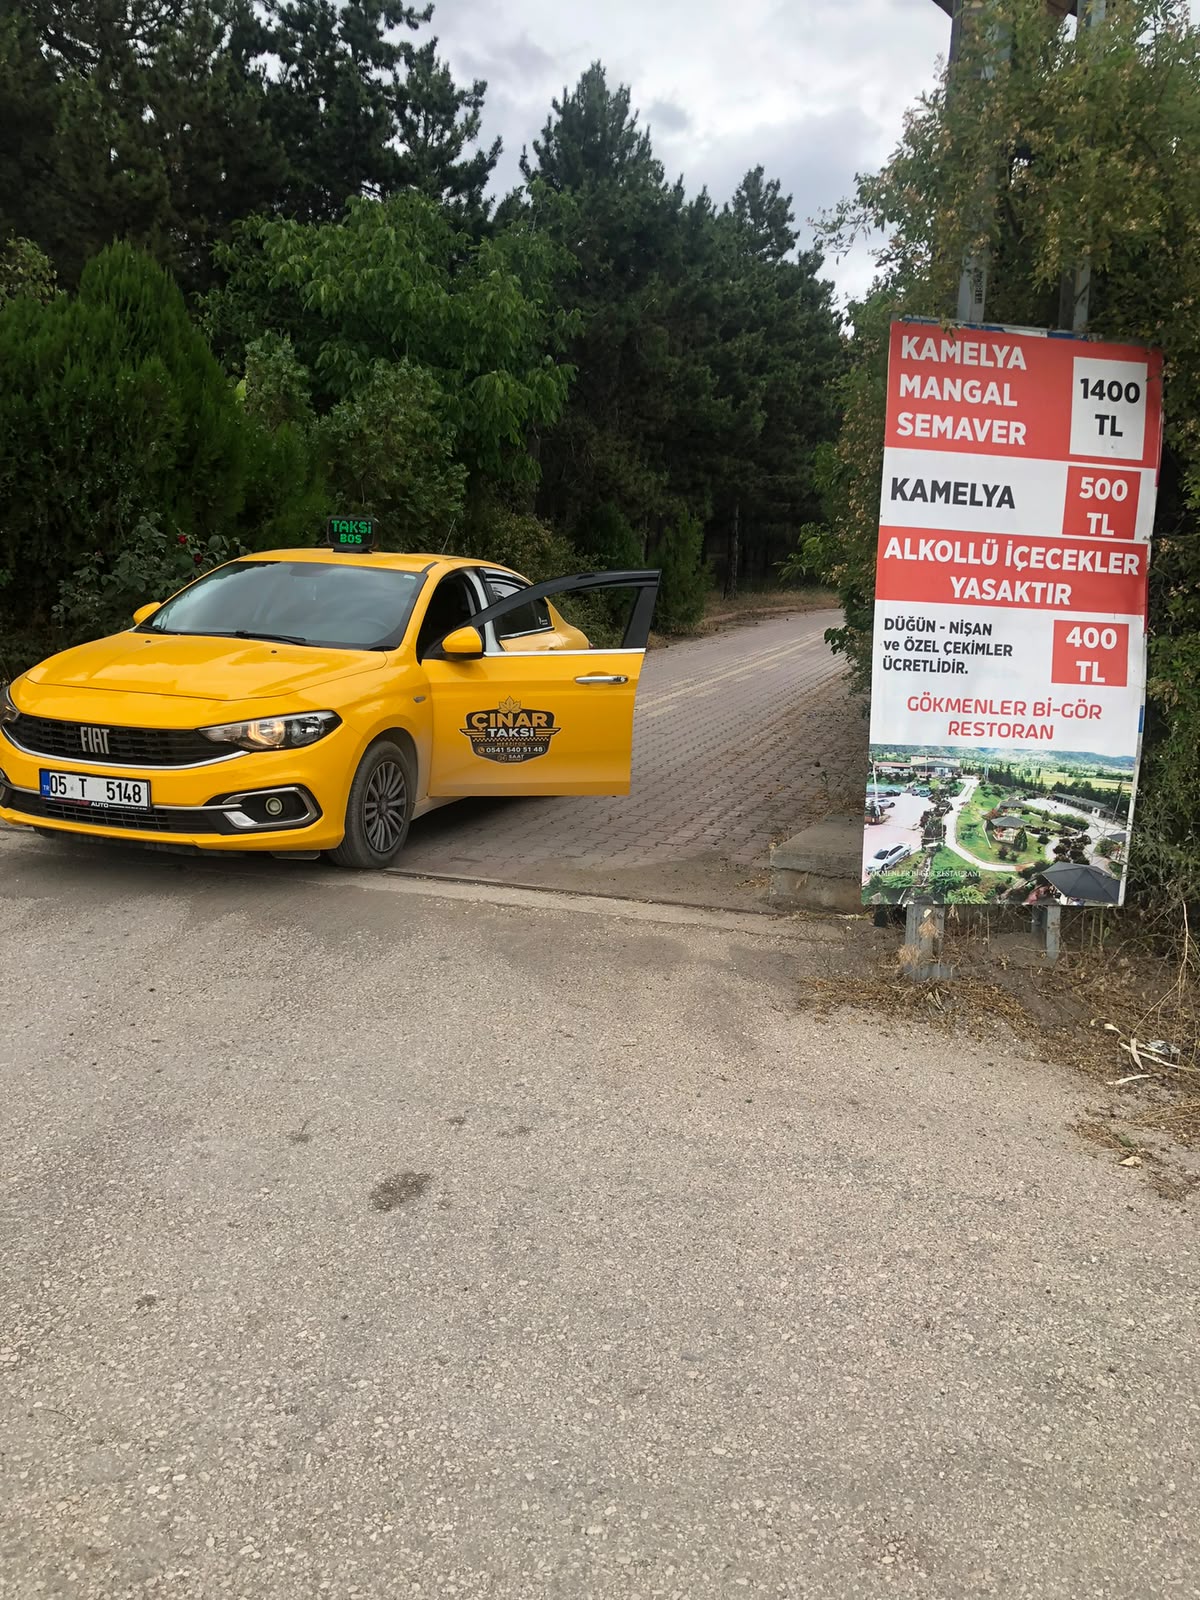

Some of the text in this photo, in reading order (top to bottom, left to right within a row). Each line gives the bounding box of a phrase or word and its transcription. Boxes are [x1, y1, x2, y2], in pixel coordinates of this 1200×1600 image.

[901, 336, 1027, 370] KAMELYA
[899, 374, 1018, 407] MANGAL
[1080, 378, 1140, 404] 1400
[896, 412, 1027, 446] SEMAVER
[1095, 414, 1124, 438] TL
[890, 477, 1016, 509] KAMELYA
[1079, 477, 1128, 502] 500
[1086, 513, 1114, 536] TL
[884, 537, 1140, 576] ALKOLLÜ İÇECEKLER
[950, 576, 1072, 605] YASAKTIR
[884, 616, 936, 632] DÜĞÜN
[949, 619, 992, 636] NİŞAN
[1066, 626, 1117, 650] 400
[884, 636, 1013, 656] ve ÖZEL ÇEKİMLER
[883, 655, 968, 674] ÜCRETLİDİR.
[1076, 660, 1106, 683] TL
[907, 692, 1102, 720] GÖKMENLER Bİ-GÖR
[471, 712, 547, 731] ÇINAR
[948, 720, 1054, 740] RESTORAN
[80, 727, 110, 754] FIAT
[50, 775, 66, 795] 05
[79, 778, 87, 798] T
[106, 781, 141, 803] 5148
